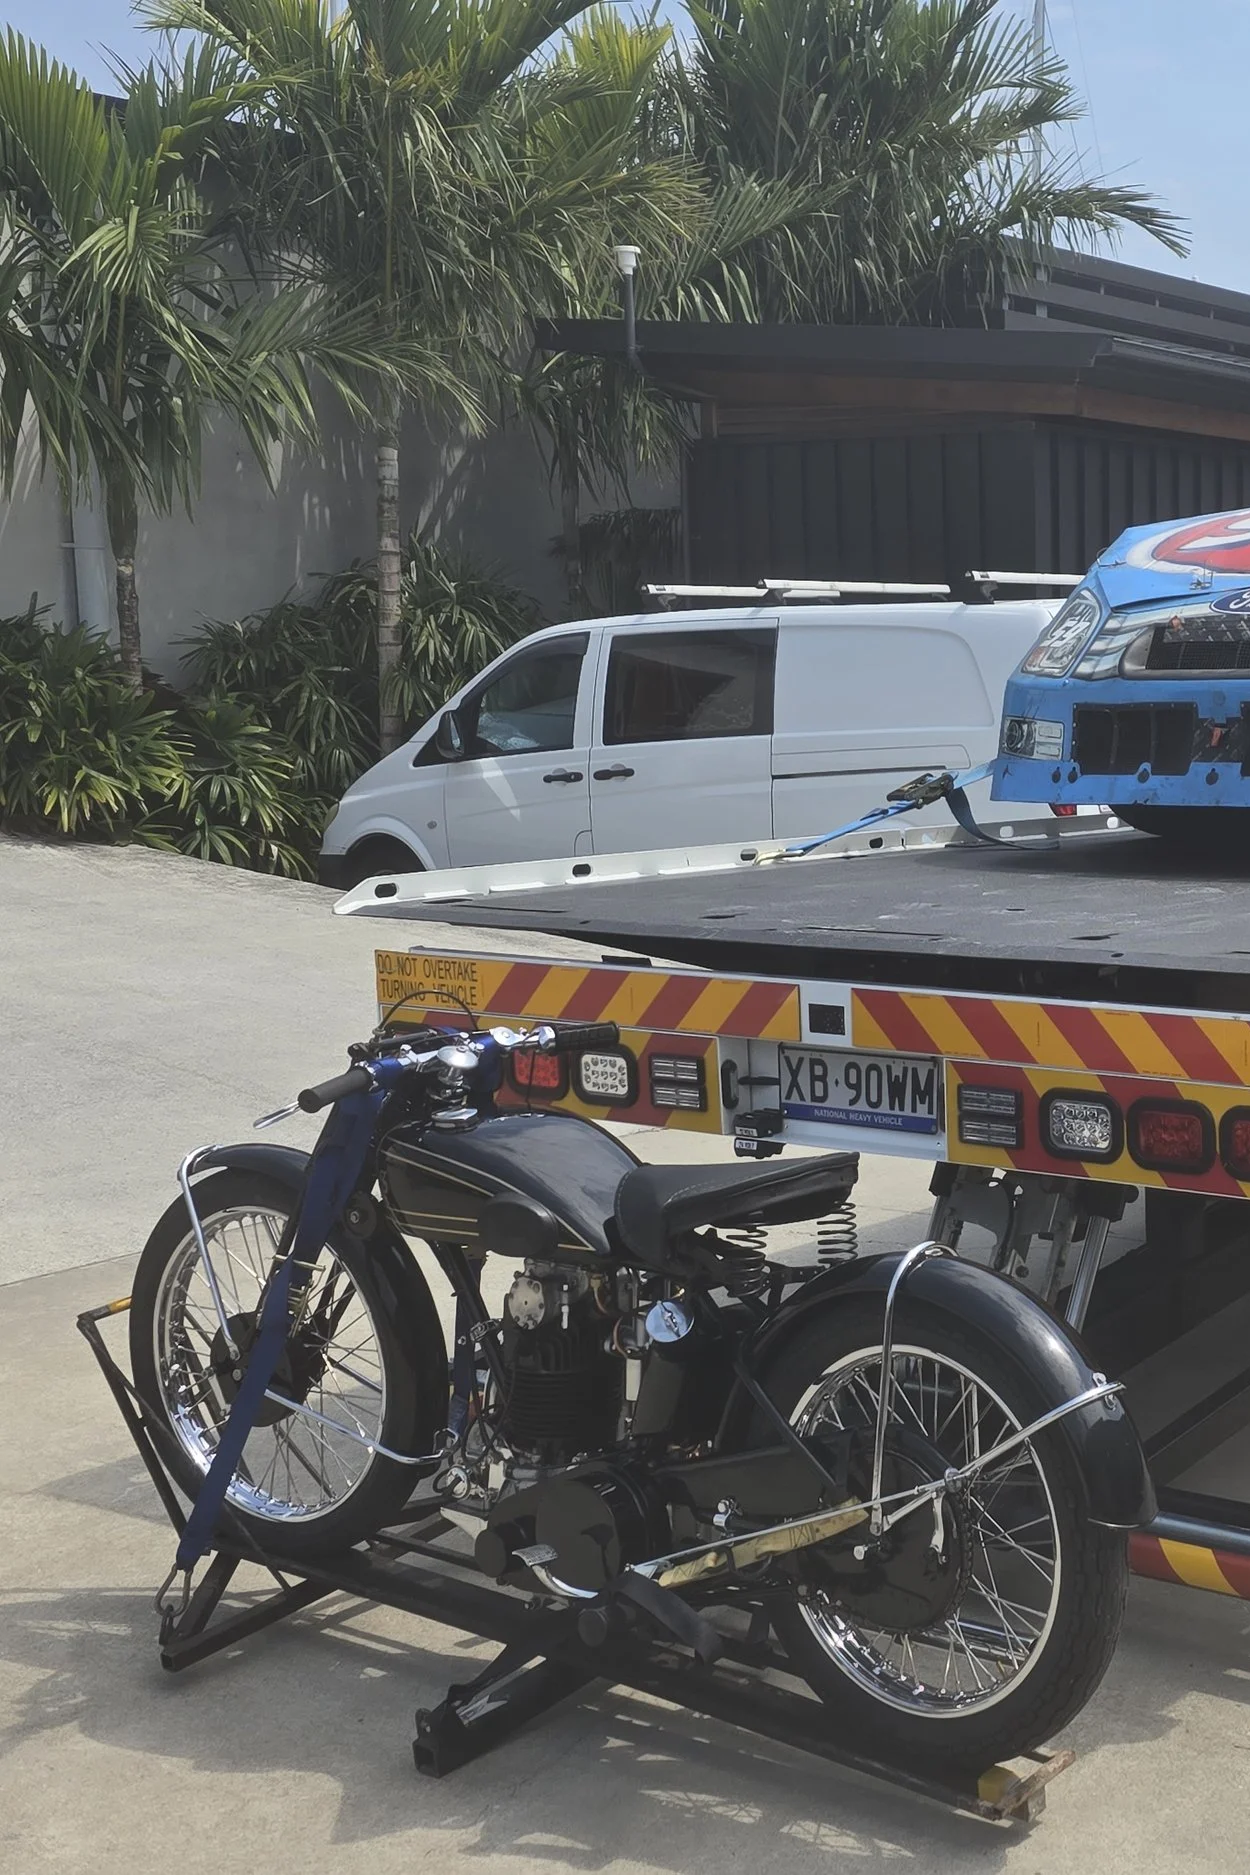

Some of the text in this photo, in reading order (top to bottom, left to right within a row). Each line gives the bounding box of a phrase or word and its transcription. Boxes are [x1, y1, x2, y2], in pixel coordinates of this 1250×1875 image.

[377, 954, 478, 982] DO NOT OVERTAKE
[380, 979, 478, 1006] TURNING VEHICLE
[814, 1108, 903, 1126] NATIONAL HEAVY VEHICLE
